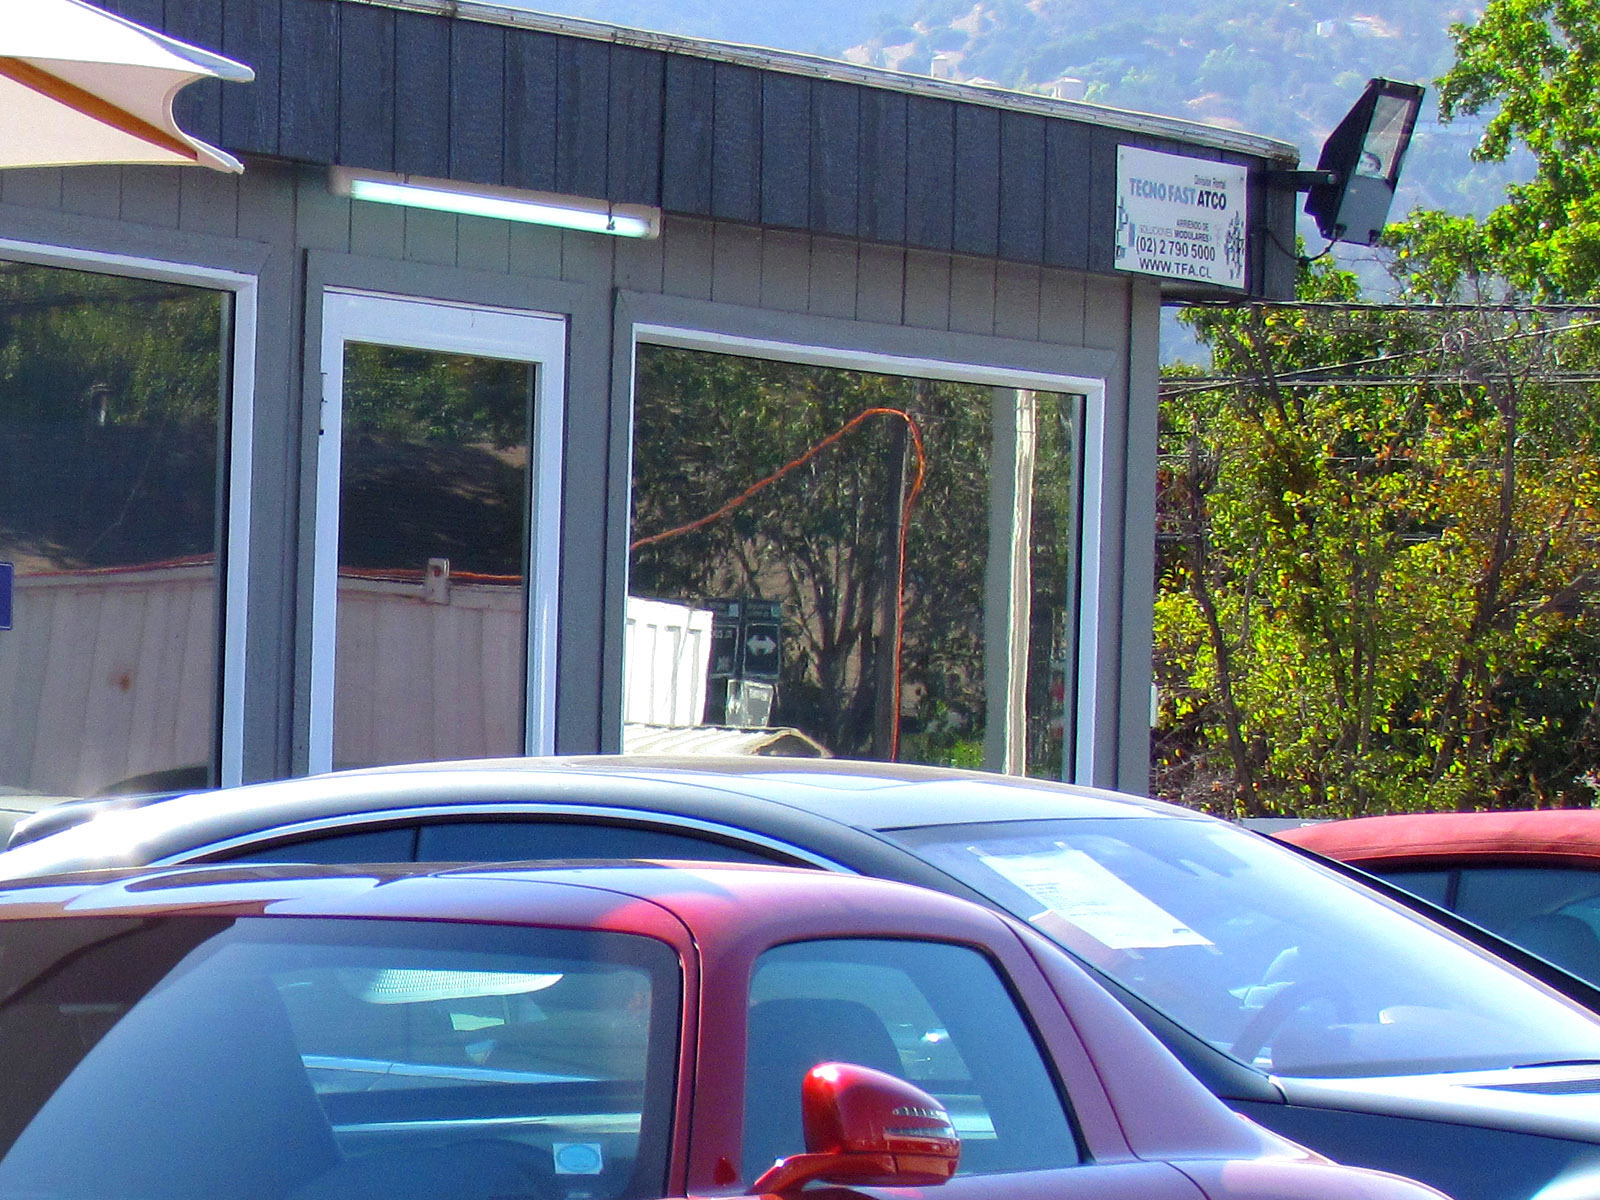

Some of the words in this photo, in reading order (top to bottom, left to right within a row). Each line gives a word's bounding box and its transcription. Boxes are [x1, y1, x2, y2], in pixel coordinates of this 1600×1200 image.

[1129, 178, 1166, 201] TECNO
[1167, 184, 1196, 205] FAST
[1197, 190, 1227, 210] ATCO
[1136, 236, 1157, 257] (02)
[1159, 239, 1167, 255] 2
[1168, 240, 1189, 258] 790
[1190, 243, 1216, 262] 5000
[1139, 258, 1212, 278] WWW.TFA.CL
